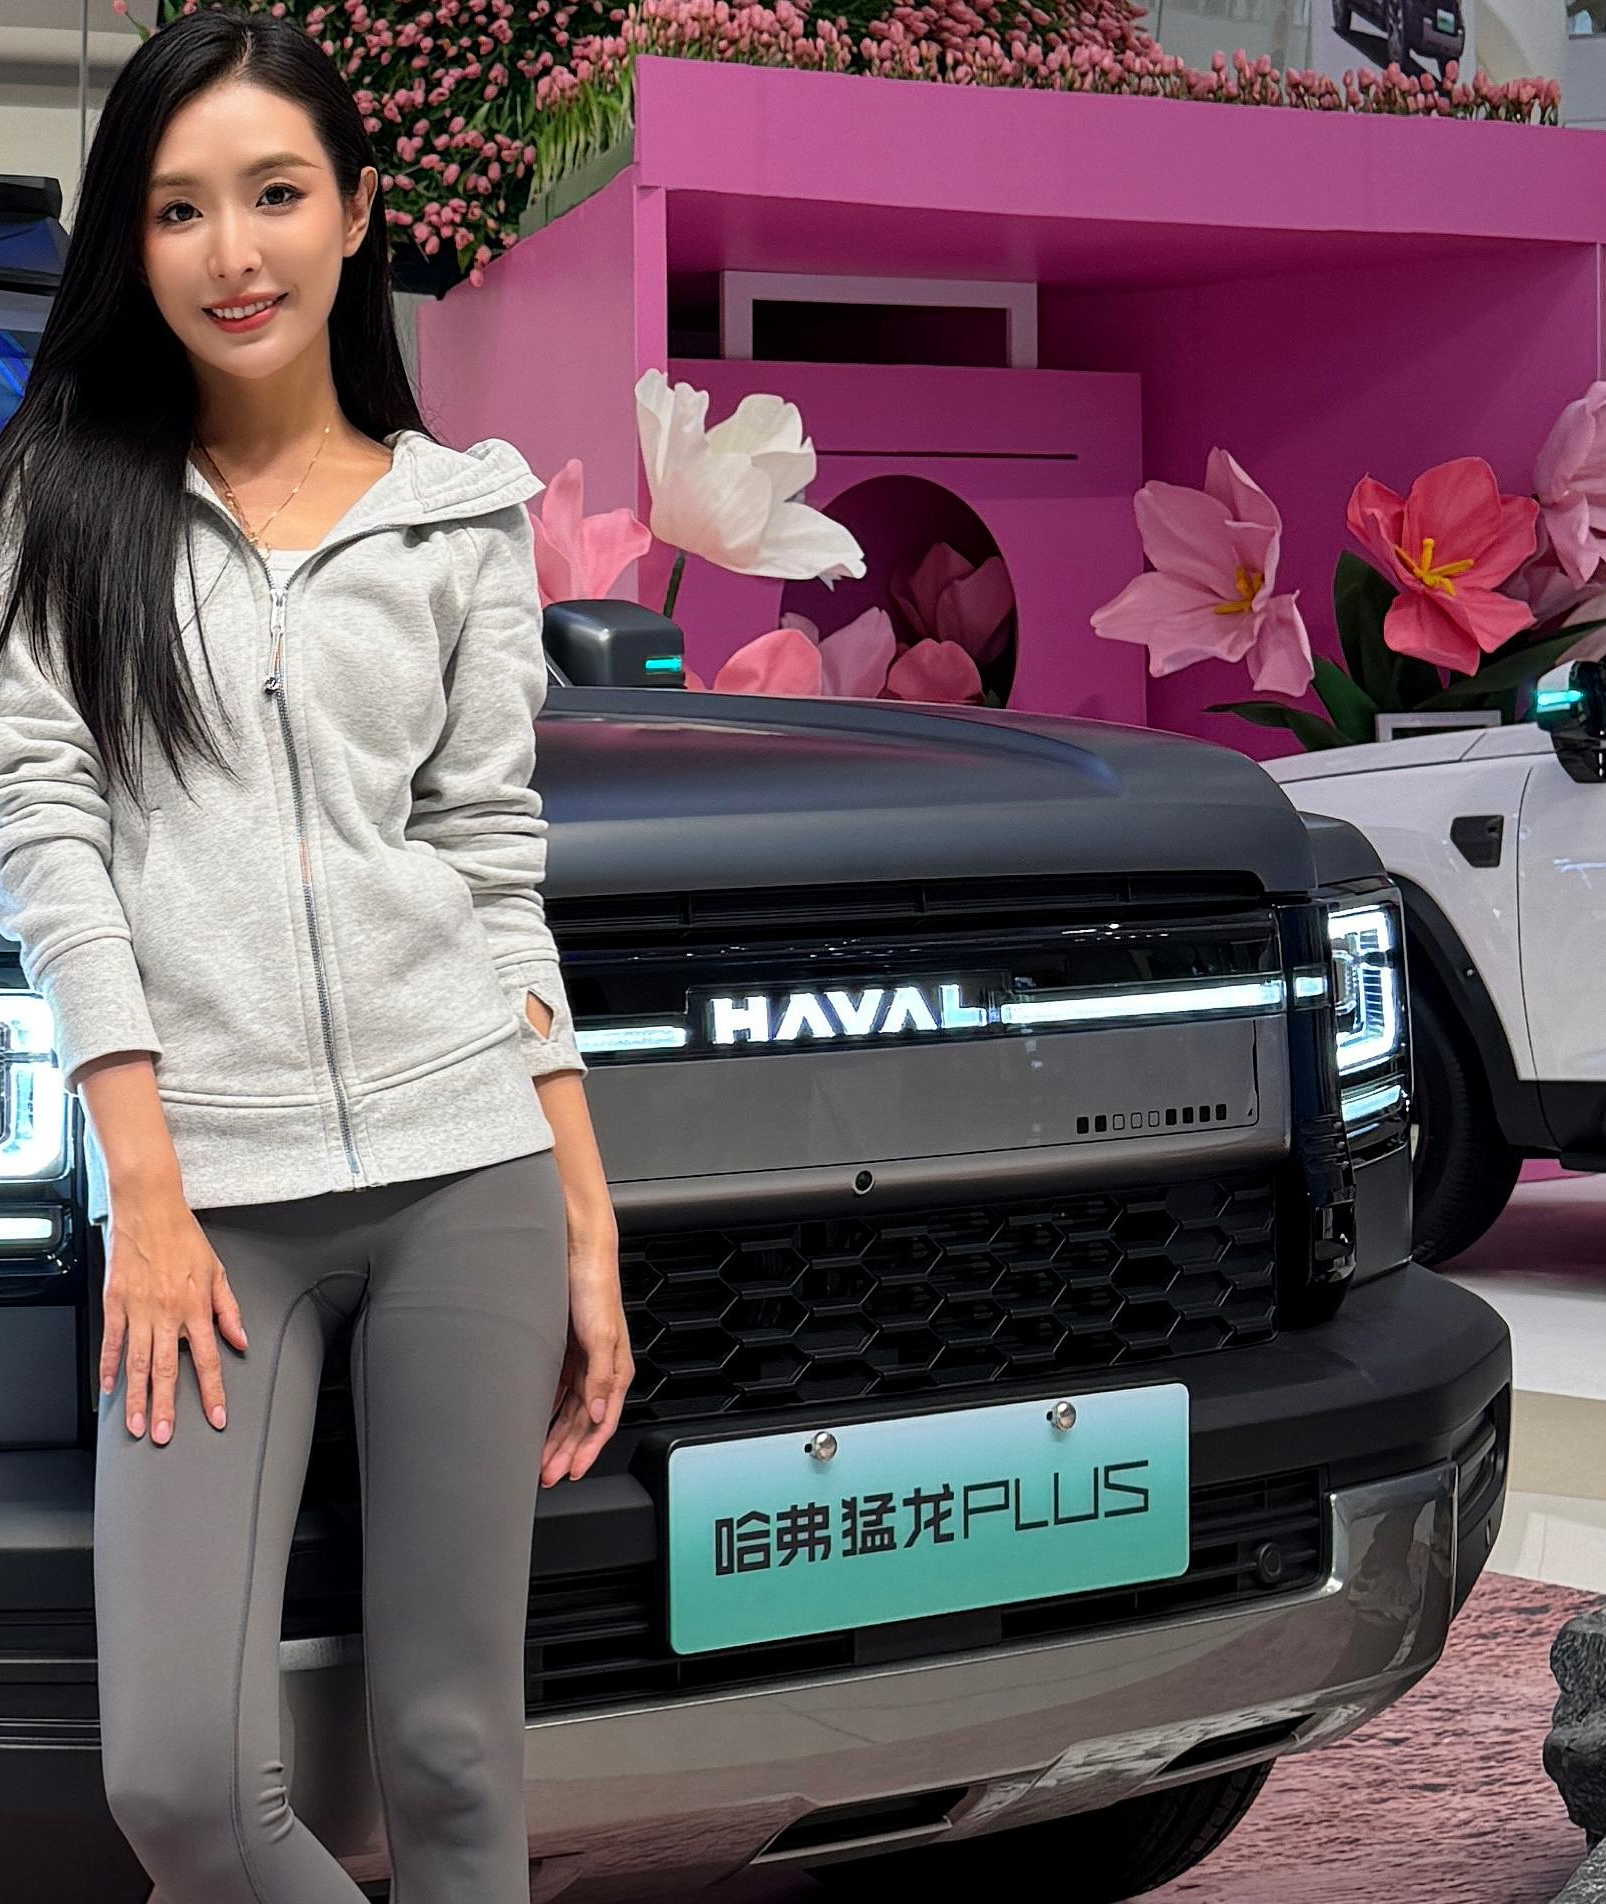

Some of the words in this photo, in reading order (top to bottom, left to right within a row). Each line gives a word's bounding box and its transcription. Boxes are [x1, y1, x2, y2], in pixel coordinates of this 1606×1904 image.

[711, 983, 987, 1045] HAVAL
[715, 1459, 1149, 1576] 哈弗猛龙PLUS
